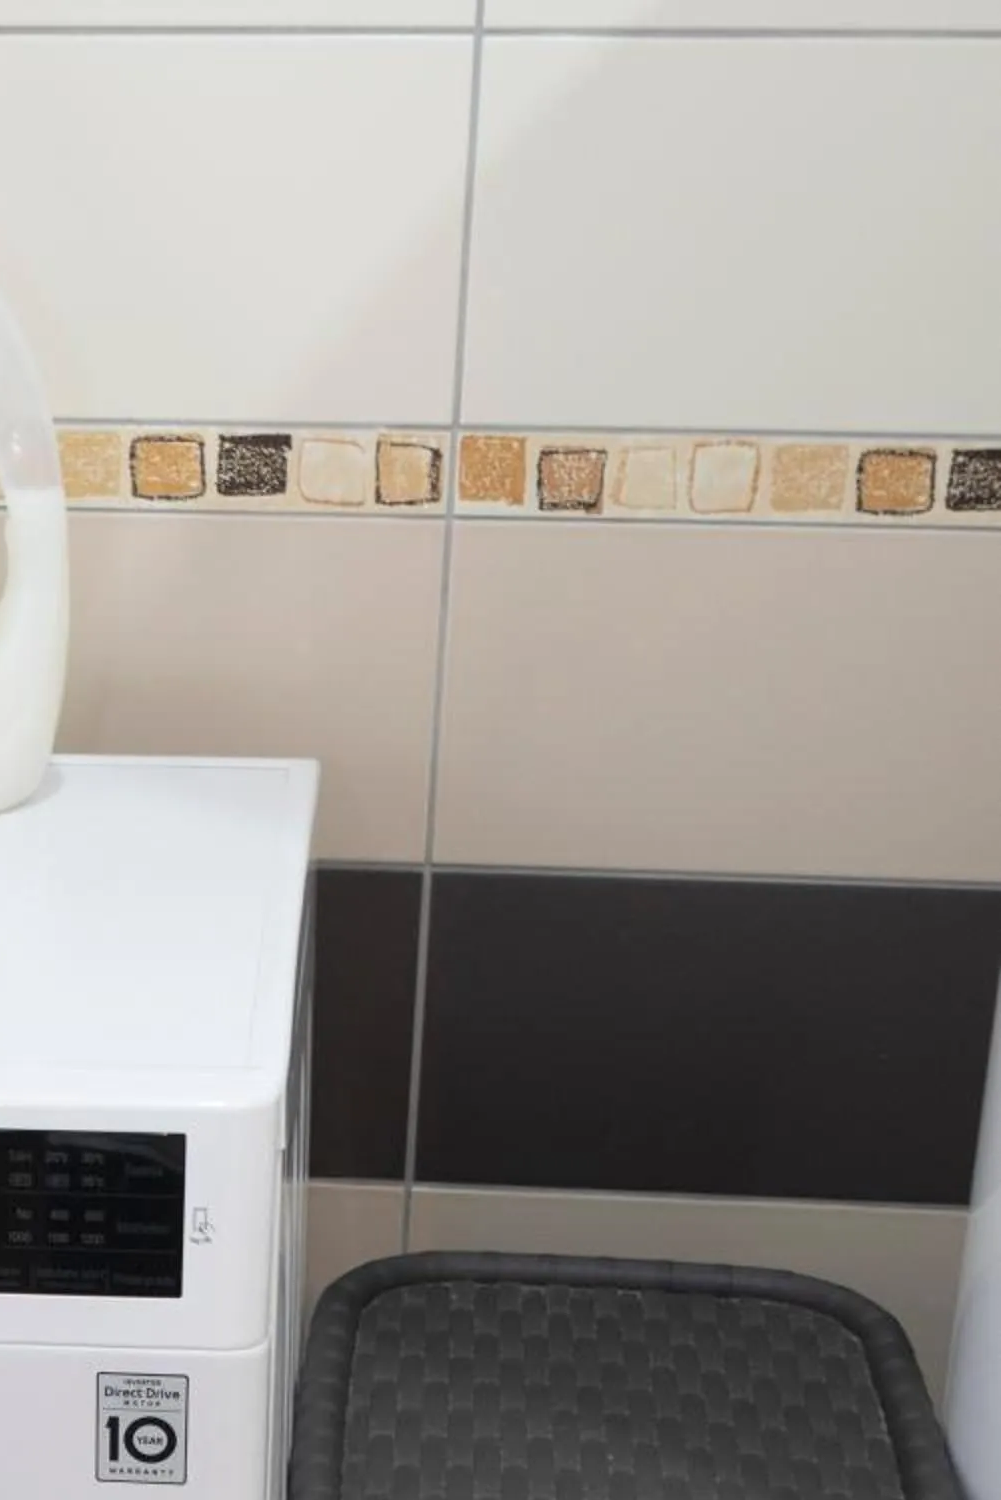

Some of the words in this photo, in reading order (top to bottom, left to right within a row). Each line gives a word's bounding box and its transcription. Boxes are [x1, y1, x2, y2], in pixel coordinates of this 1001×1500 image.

[104, 1385, 142, 1399] Direct
[146, 1387, 181, 1400] Drive
[105, 1415, 177, 1464] 10
